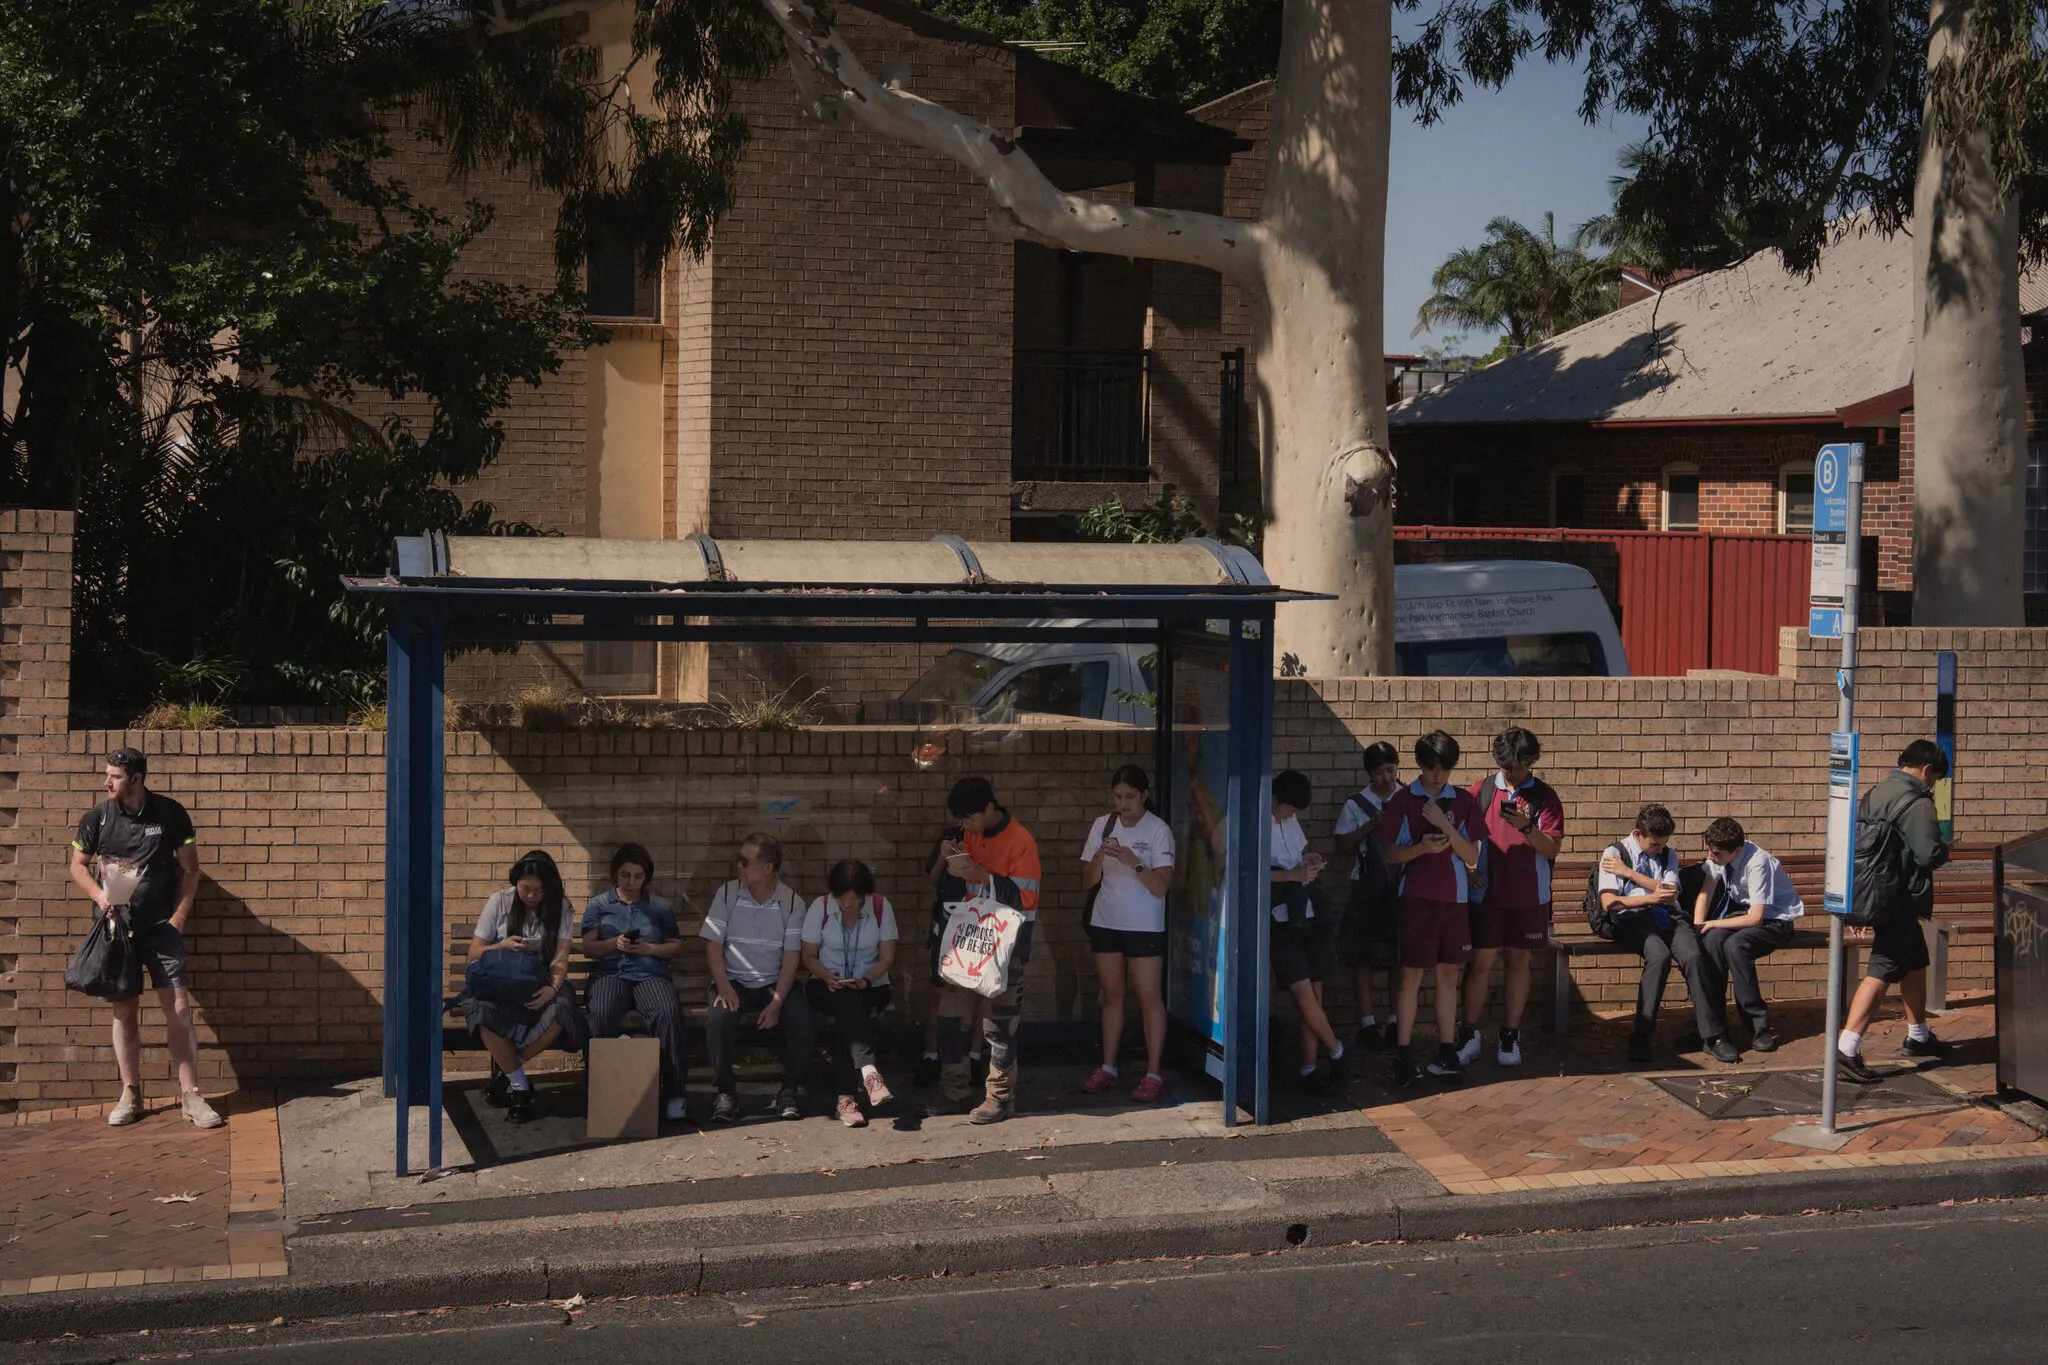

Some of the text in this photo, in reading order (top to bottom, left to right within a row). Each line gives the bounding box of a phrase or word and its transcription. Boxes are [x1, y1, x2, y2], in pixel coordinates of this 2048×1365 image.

[1824, 460, 1832, 484] B
[1814, 533, 1826, 542] Stand
[1496, 595, 1535, 605] Hurlstone
[1536, 592, 1555, 602] Park
[1409, 611, 1427, 623] Park
[1429, 611, 1476, 622] Vietnamese
[1477, 608, 1505, 619] Baptist
[1507, 606, 1536, 617] Church
[1832, 613, 1841, 634] A
[965, 923, 994, 942] CHOOSE
[955, 935, 966, 949] TO
